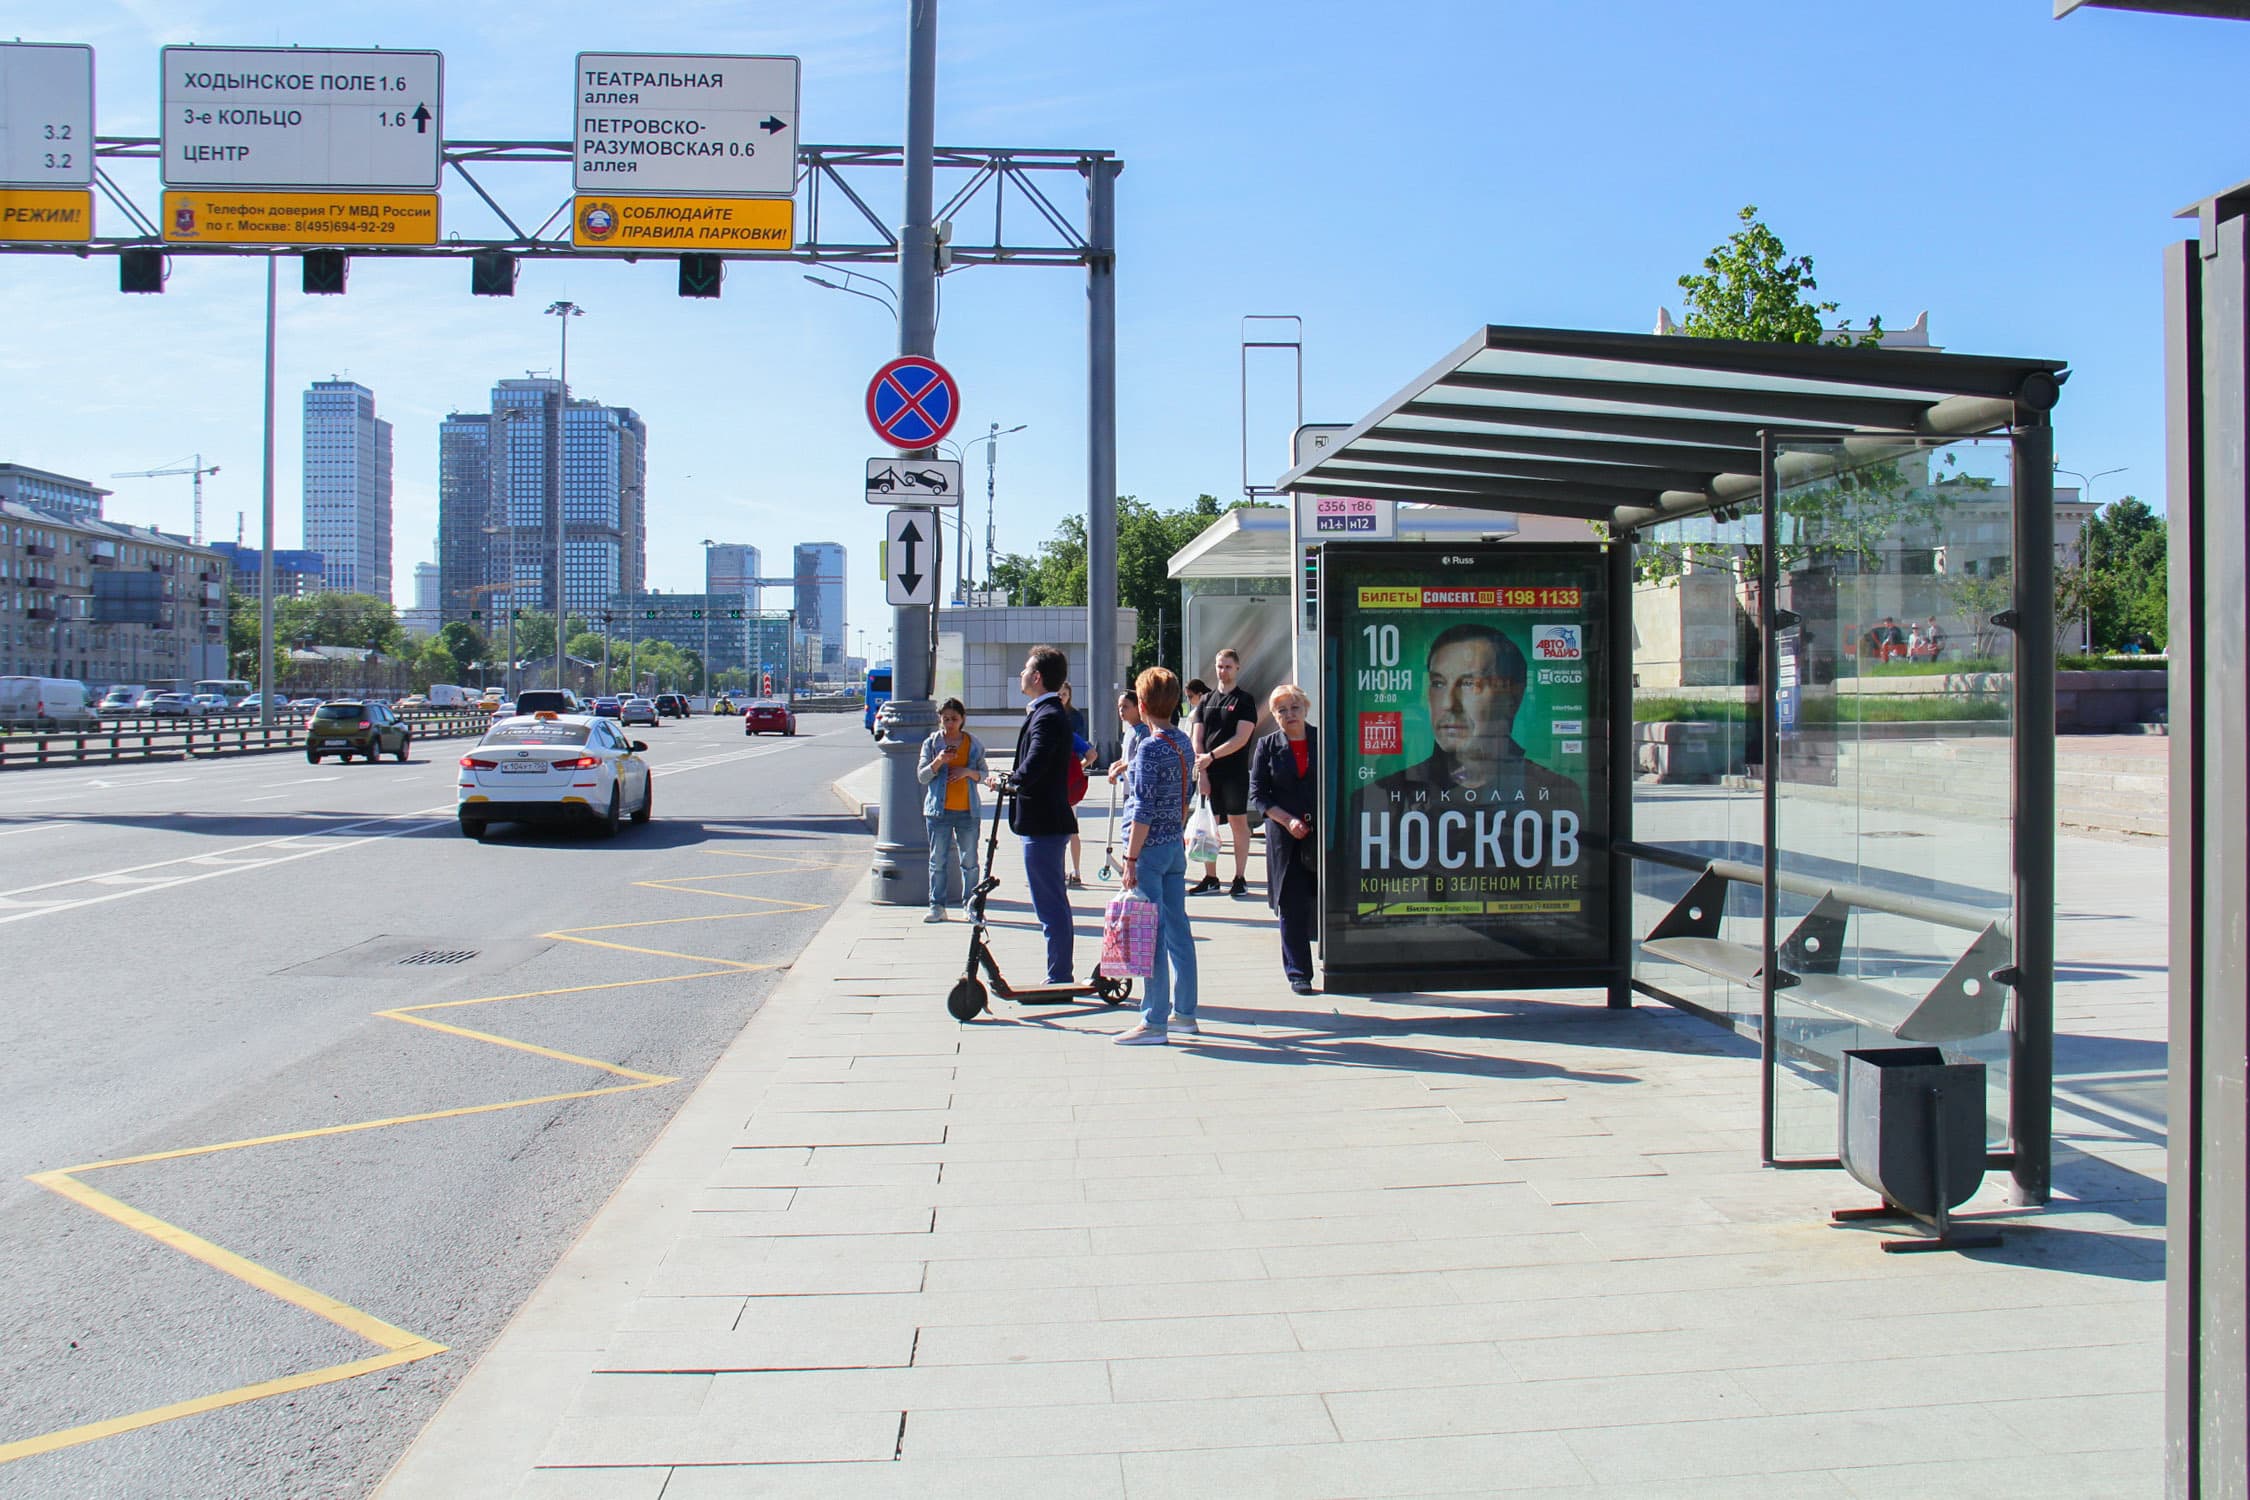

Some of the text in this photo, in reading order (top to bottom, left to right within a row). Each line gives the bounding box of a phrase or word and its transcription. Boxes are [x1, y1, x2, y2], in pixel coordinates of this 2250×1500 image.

[183, 72, 407, 92] ХОДЫНСКОЕ ПОЛЕ 1.6
[584, 71, 724, 88] ТЕАТРАЛЬНАЯ
[584, 92, 640, 105] аллея
[183, 109, 407, 129] 3-е КОЛЬЦО 1.6
[44, 124, 72, 140] 3.2
[584, 119, 707, 136] ПЕТРОВСКО-
[183, 145, 250, 164] ЦЕНТР
[583, 140, 756, 158] РАЗУМОВСКАЯ 0.6
[44, 152, 73, 169] 3.2
[582, 160, 638, 173] аллея
[2, 207, 82, 223] РЕЖИМ!
[206, 203, 432, 218] Телефон доверия ГУ МВД России
[621, 205, 733, 222] СОБЛЮДАЙТЕ
[205, 221, 396, 233] по г. Москве: 8(495)694-92-29
[621, 225, 788, 241] ПРАВИЛА ПАРКОВКИ!
[1318, 501, 1373, 513] с356 т86
[1452, 556, 1475, 565] Russ
[1361, 591, 1418, 603] БИЛЕТЫ
[1505, 589, 1535, 605] 198
[1539, 589, 1579, 605] 1133
[1362, 624, 1400, 667] 10
[1535, 639, 1565, 649] АВТО
[1358, 669, 1413, 691] ИЮНЯ
[1553, 675, 1583, 684] GOLD
[1374, 693, 1397, 703] 20:00
[1364, 740, 1397, 749] ВДНХ
[1358, 766, 1377, 780] 6+
[1390, 787, 1549, 802] НИКОЛАЙ
[1359, 809, 1580, 870] НОСКОВ
[1360, 874, 1579, 895] КОНЦЕРТ В ЗЕЛЕНОМ ТЕАТРЕ
[1406, 904, 1443, 913] Билеты
